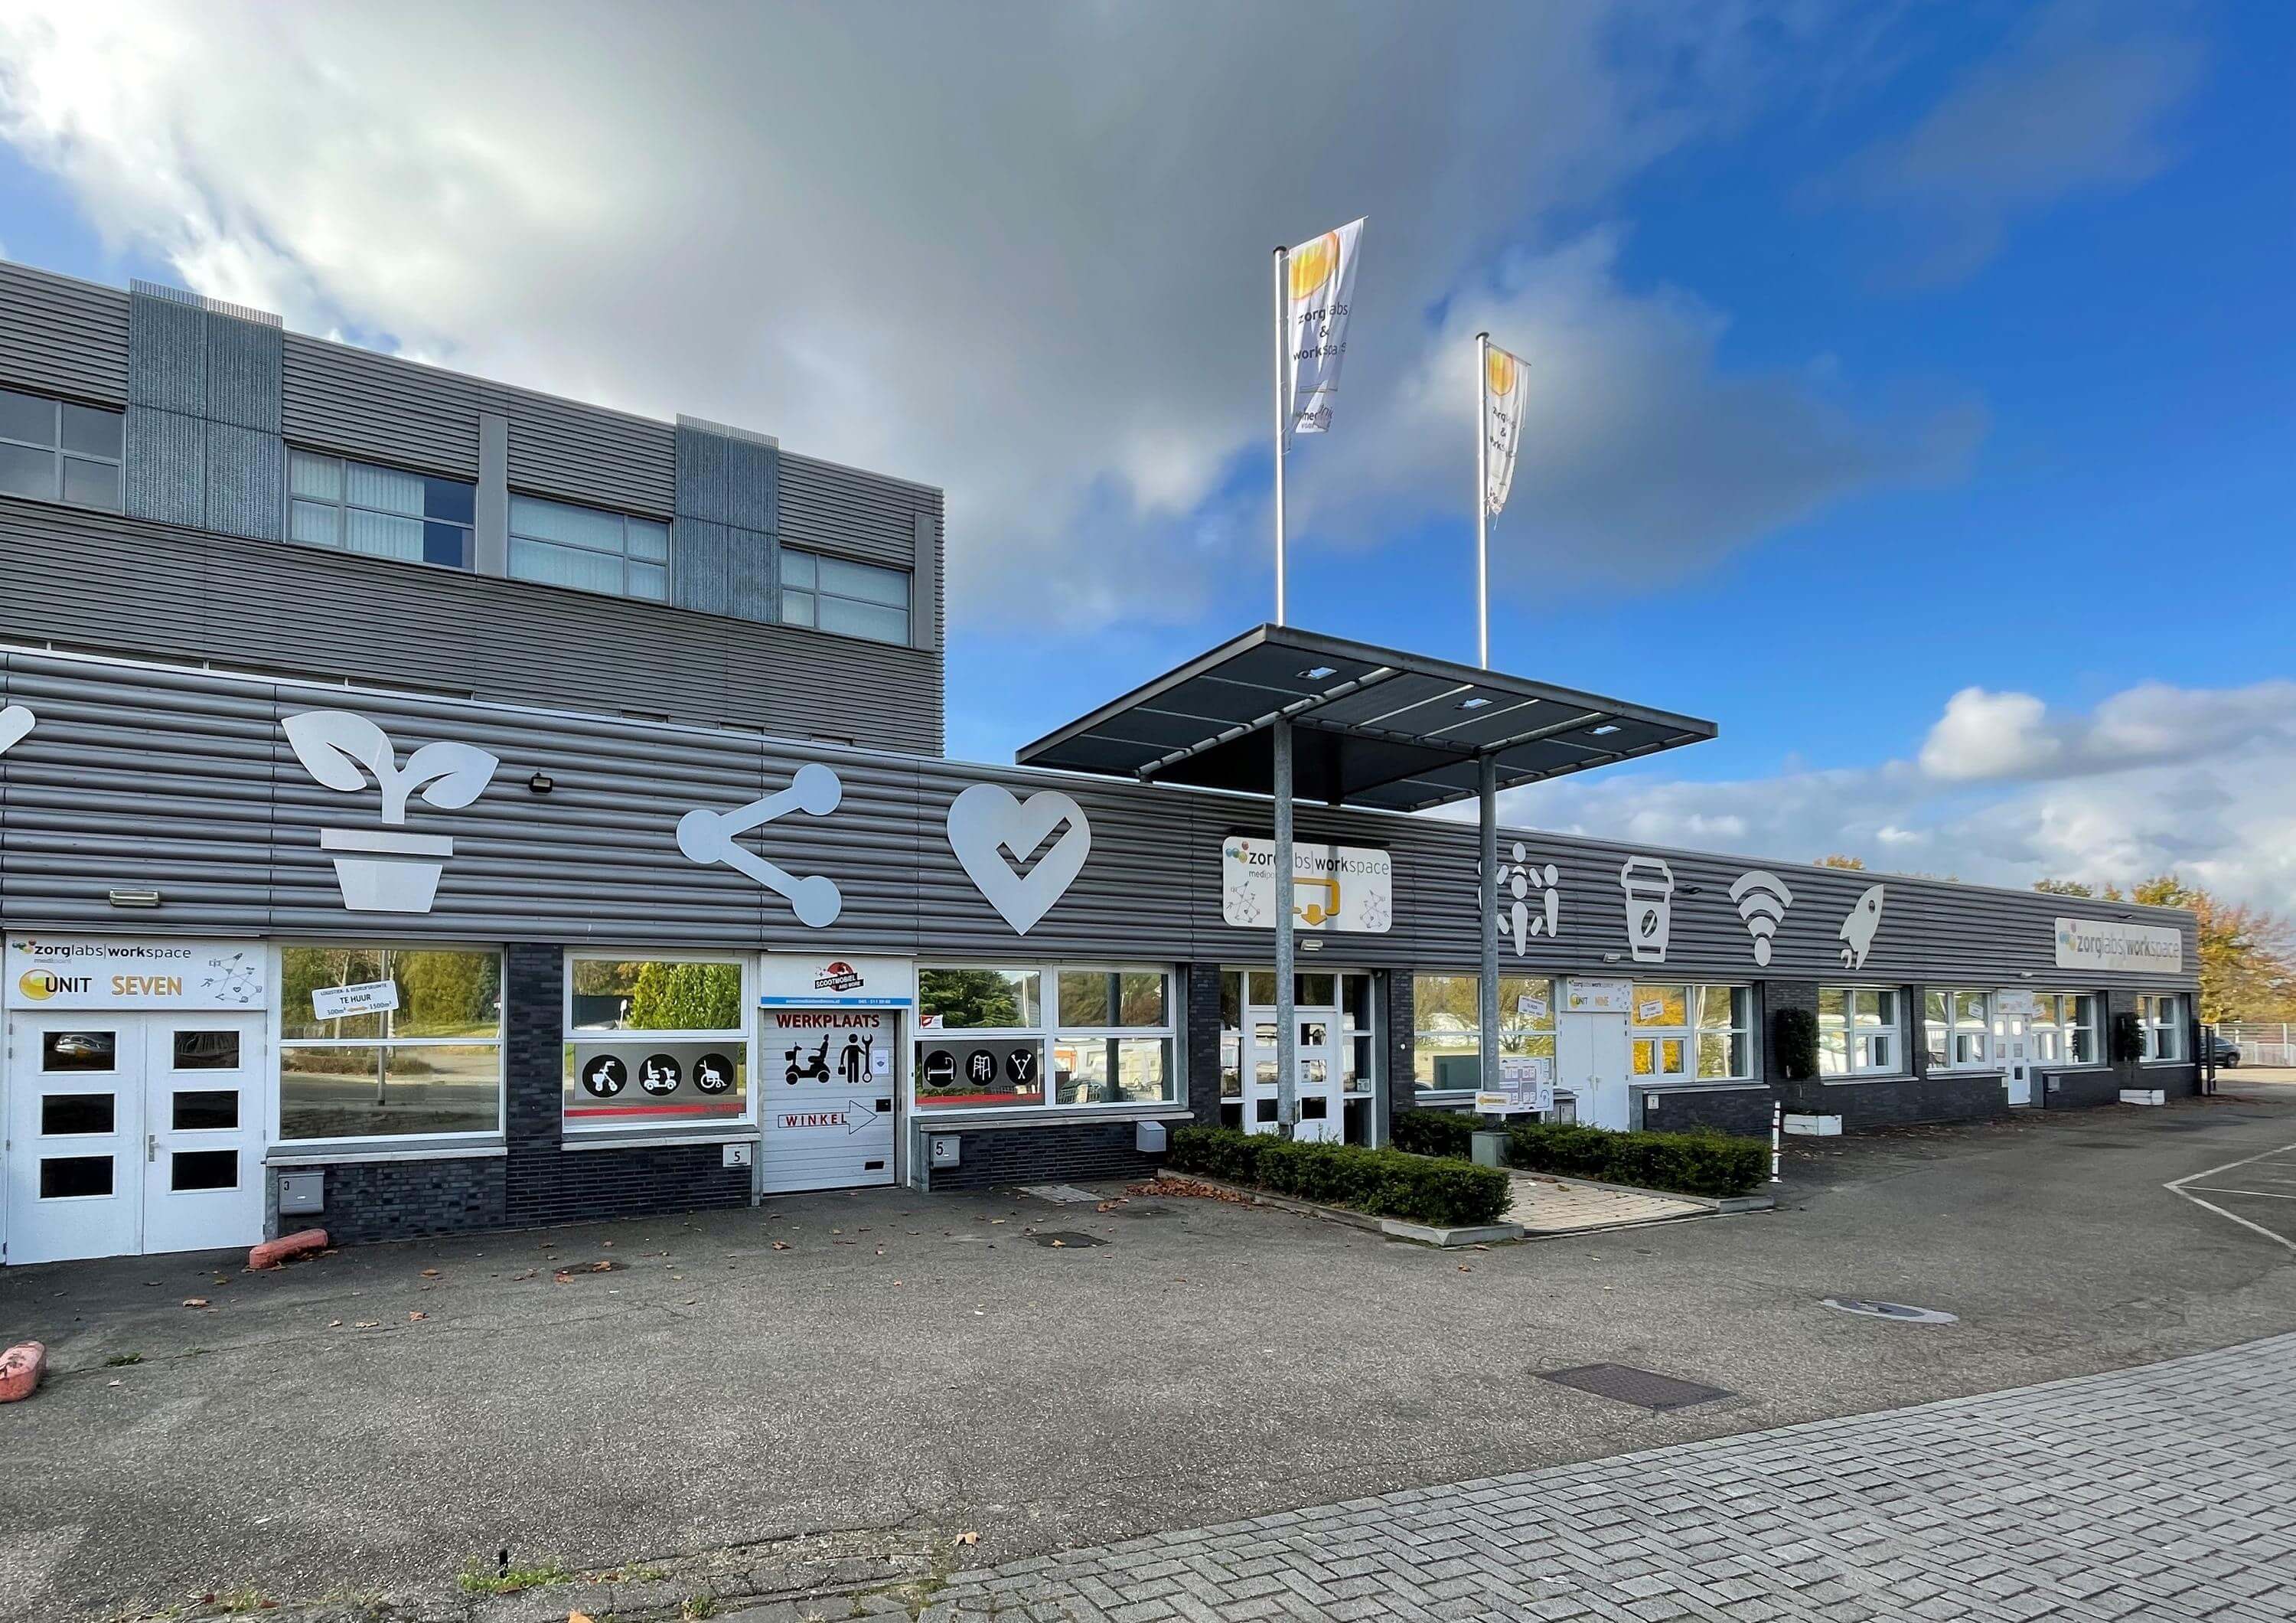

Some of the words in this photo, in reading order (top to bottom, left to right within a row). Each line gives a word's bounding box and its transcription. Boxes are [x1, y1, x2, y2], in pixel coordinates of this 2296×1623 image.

[1319, 325, 1329, 338] &
[45, 977, 92, 994] UNIT
[111, 975, 183, 996] SEVEN
[816, 975, 856, 988] SCOOTMOBIEL
[351, 994, 372, 1003] HUUR
[776, 1014, 879, 1029] WERKPLAATS
[786, 1113, 847, 1126] WINKEL
[935, 1141, 944, 1156] 5
[733, 1151, 741, 1162] 5
[284, 1181, 290, 1191] 3
